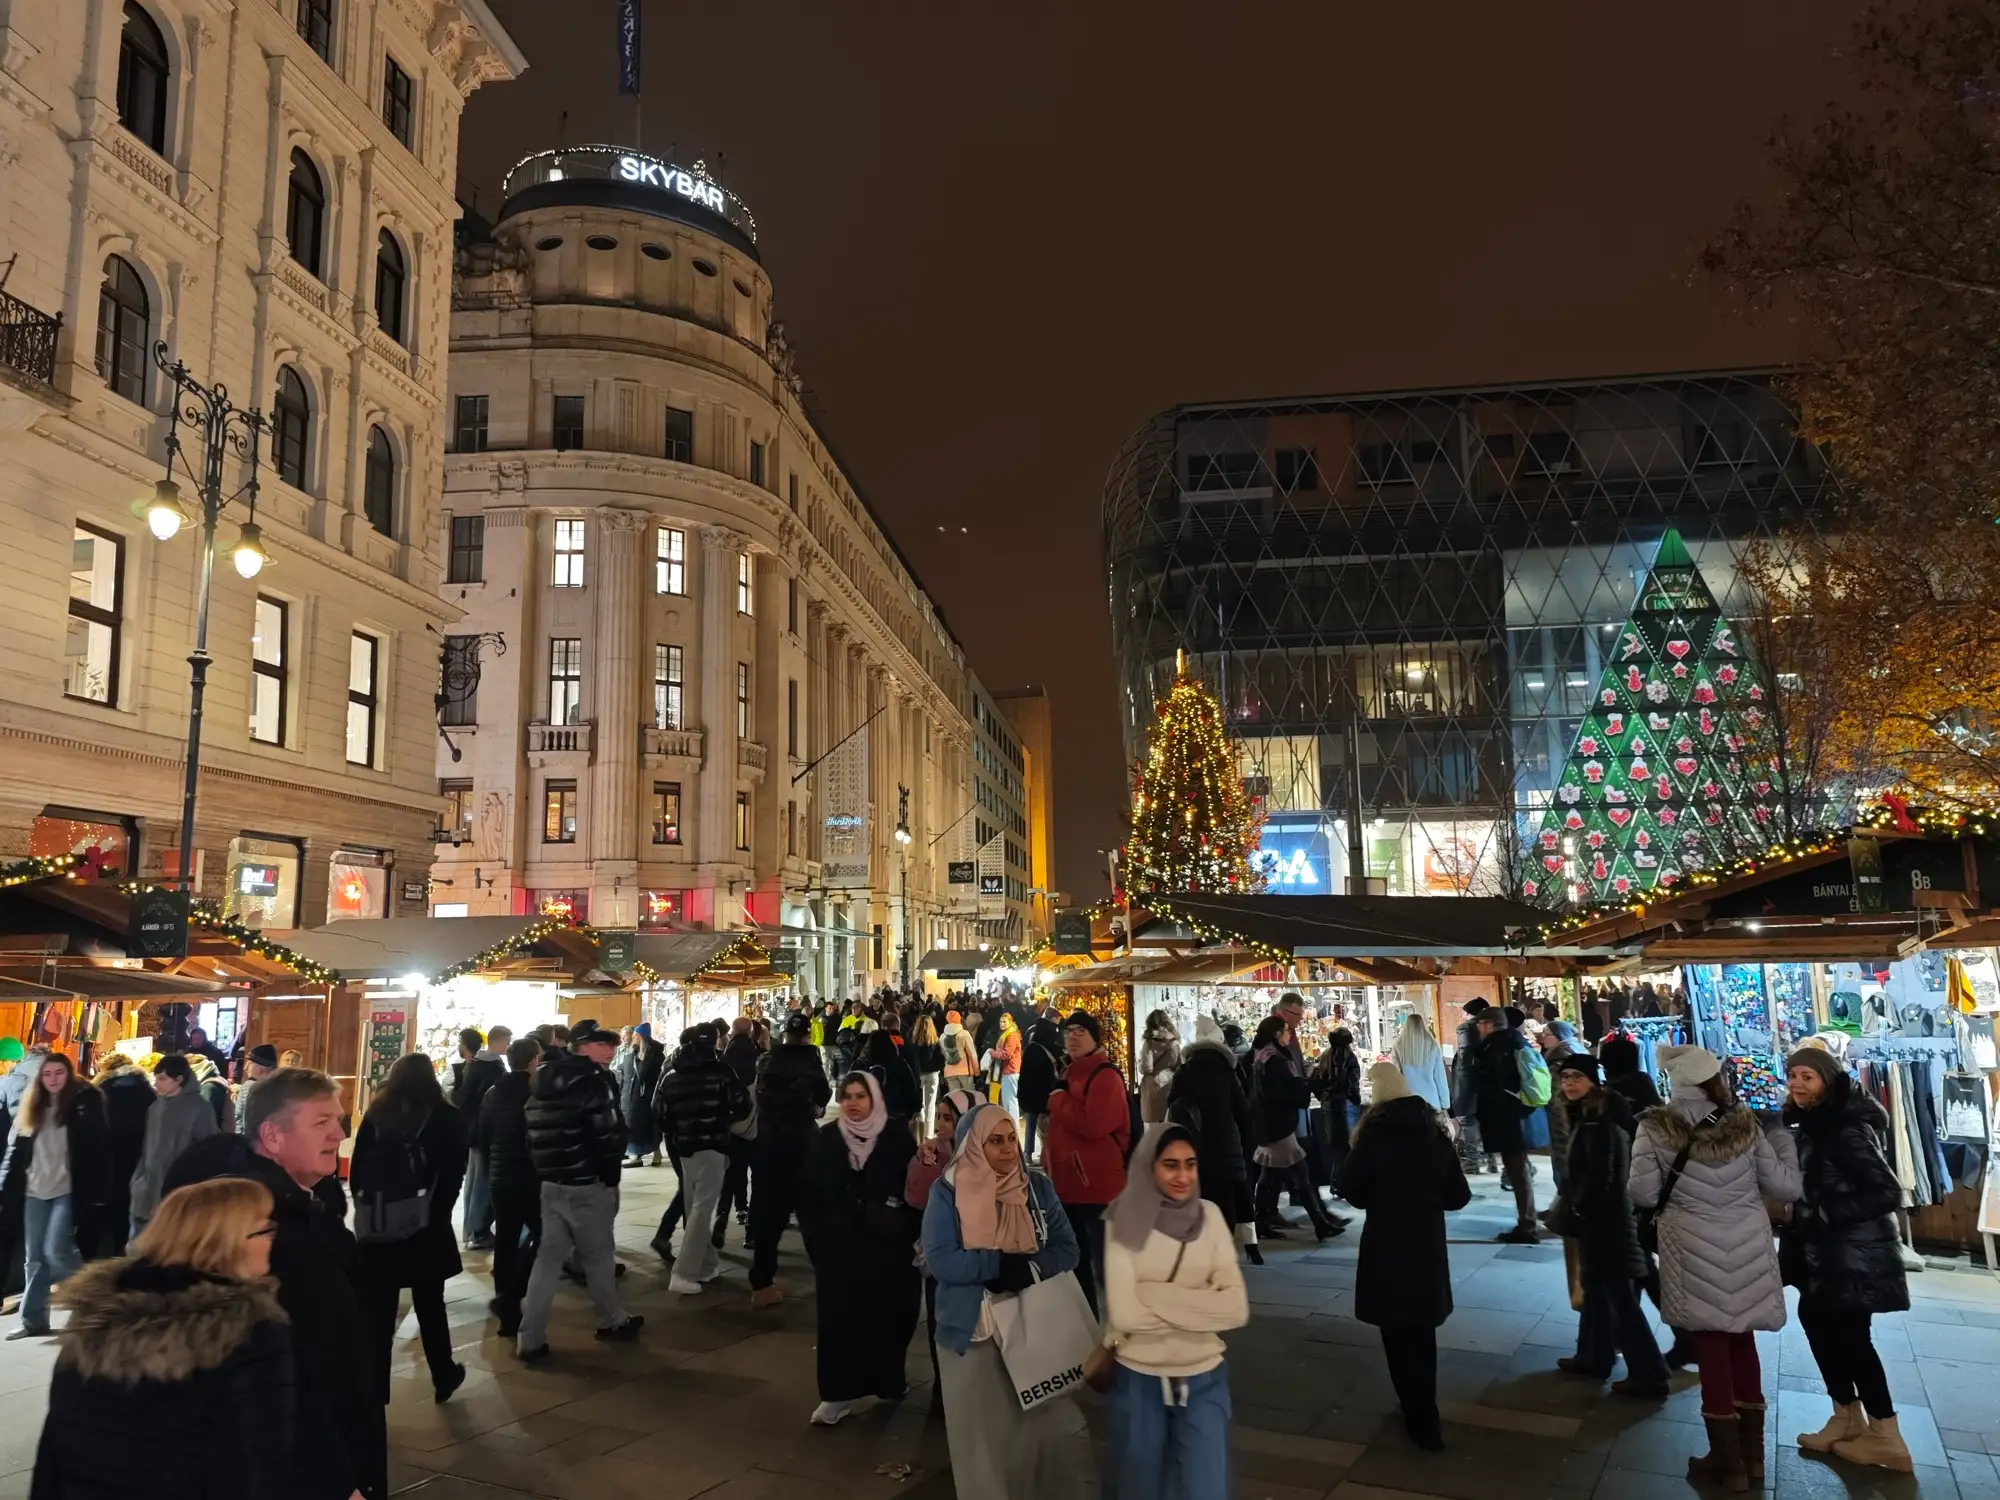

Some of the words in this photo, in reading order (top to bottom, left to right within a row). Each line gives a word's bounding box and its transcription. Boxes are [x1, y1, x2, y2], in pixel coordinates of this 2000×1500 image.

[620, 157, 724, 213] SKYBAR
[248, 841, 268, 854] Red
[1911, 869, 1931, 889] 8B
[1813, 883, 1849, 897] BÁNYAI
[1020, 1364, 1084, 1405] BERSHK
